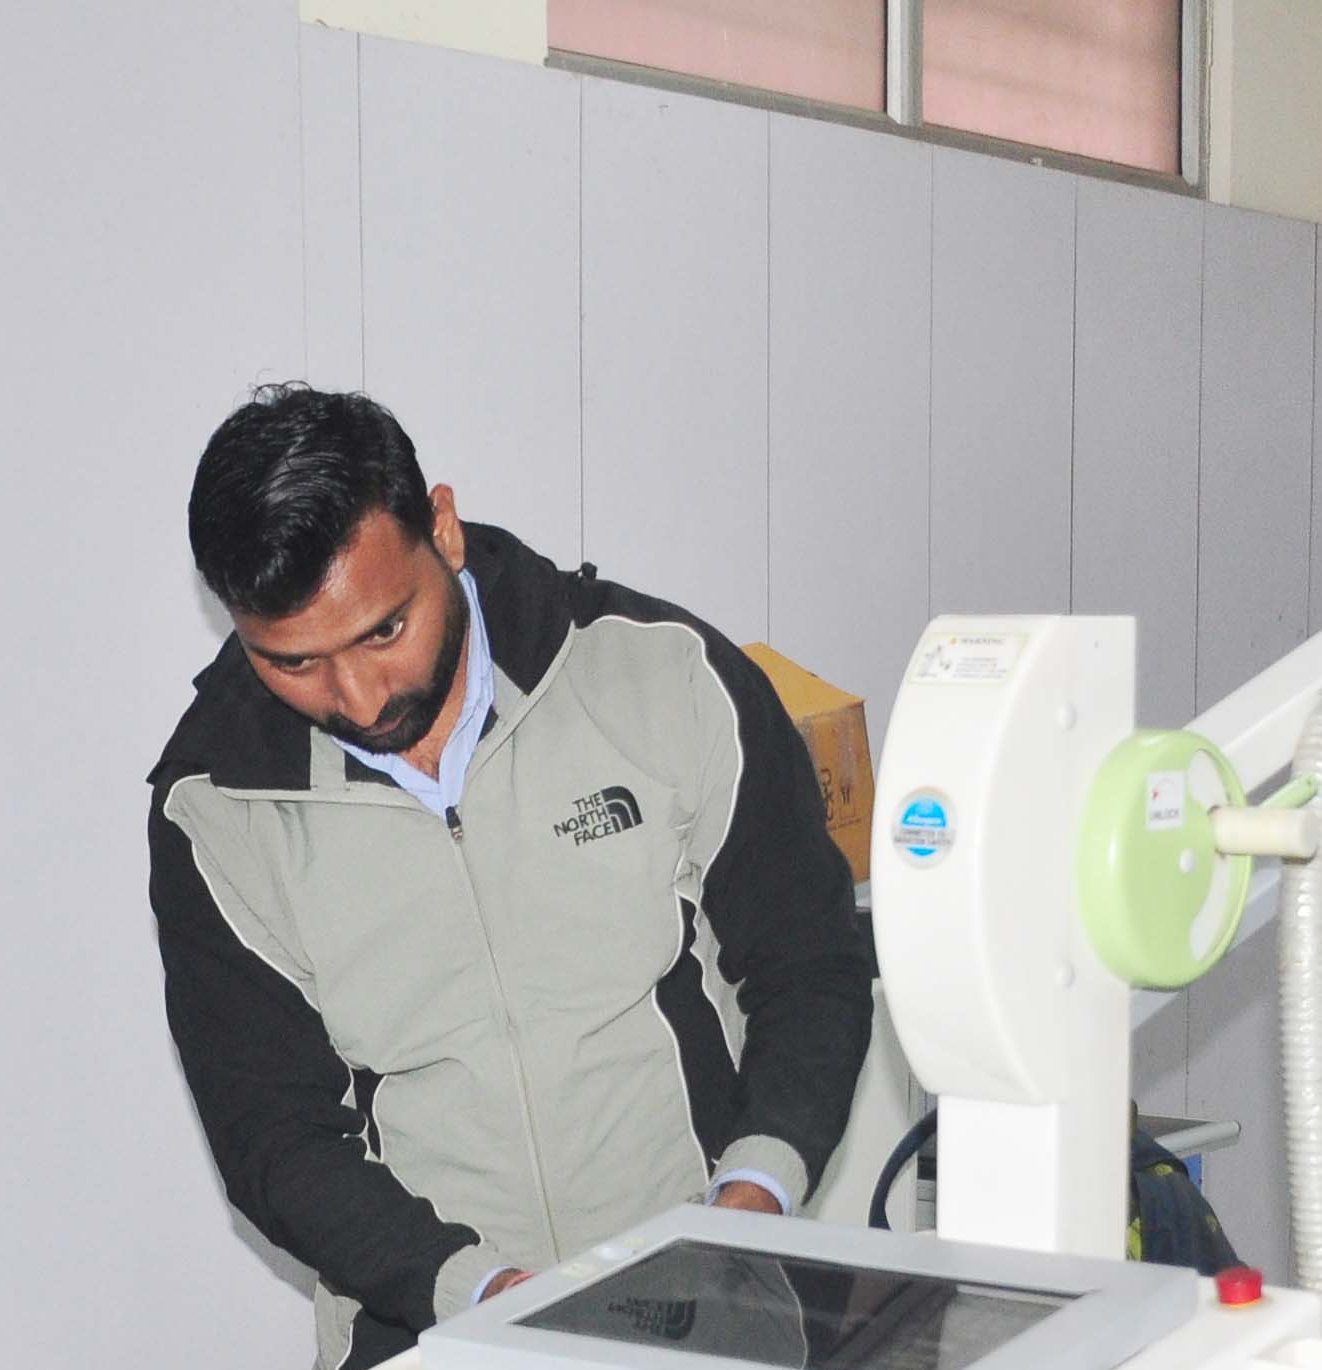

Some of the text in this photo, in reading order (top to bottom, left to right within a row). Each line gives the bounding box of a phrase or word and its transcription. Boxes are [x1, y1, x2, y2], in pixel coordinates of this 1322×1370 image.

[572, 791, 603, 813] THE
[553, 805, 608, 838] NORTH
[574, 820, 615, 847] FACE
